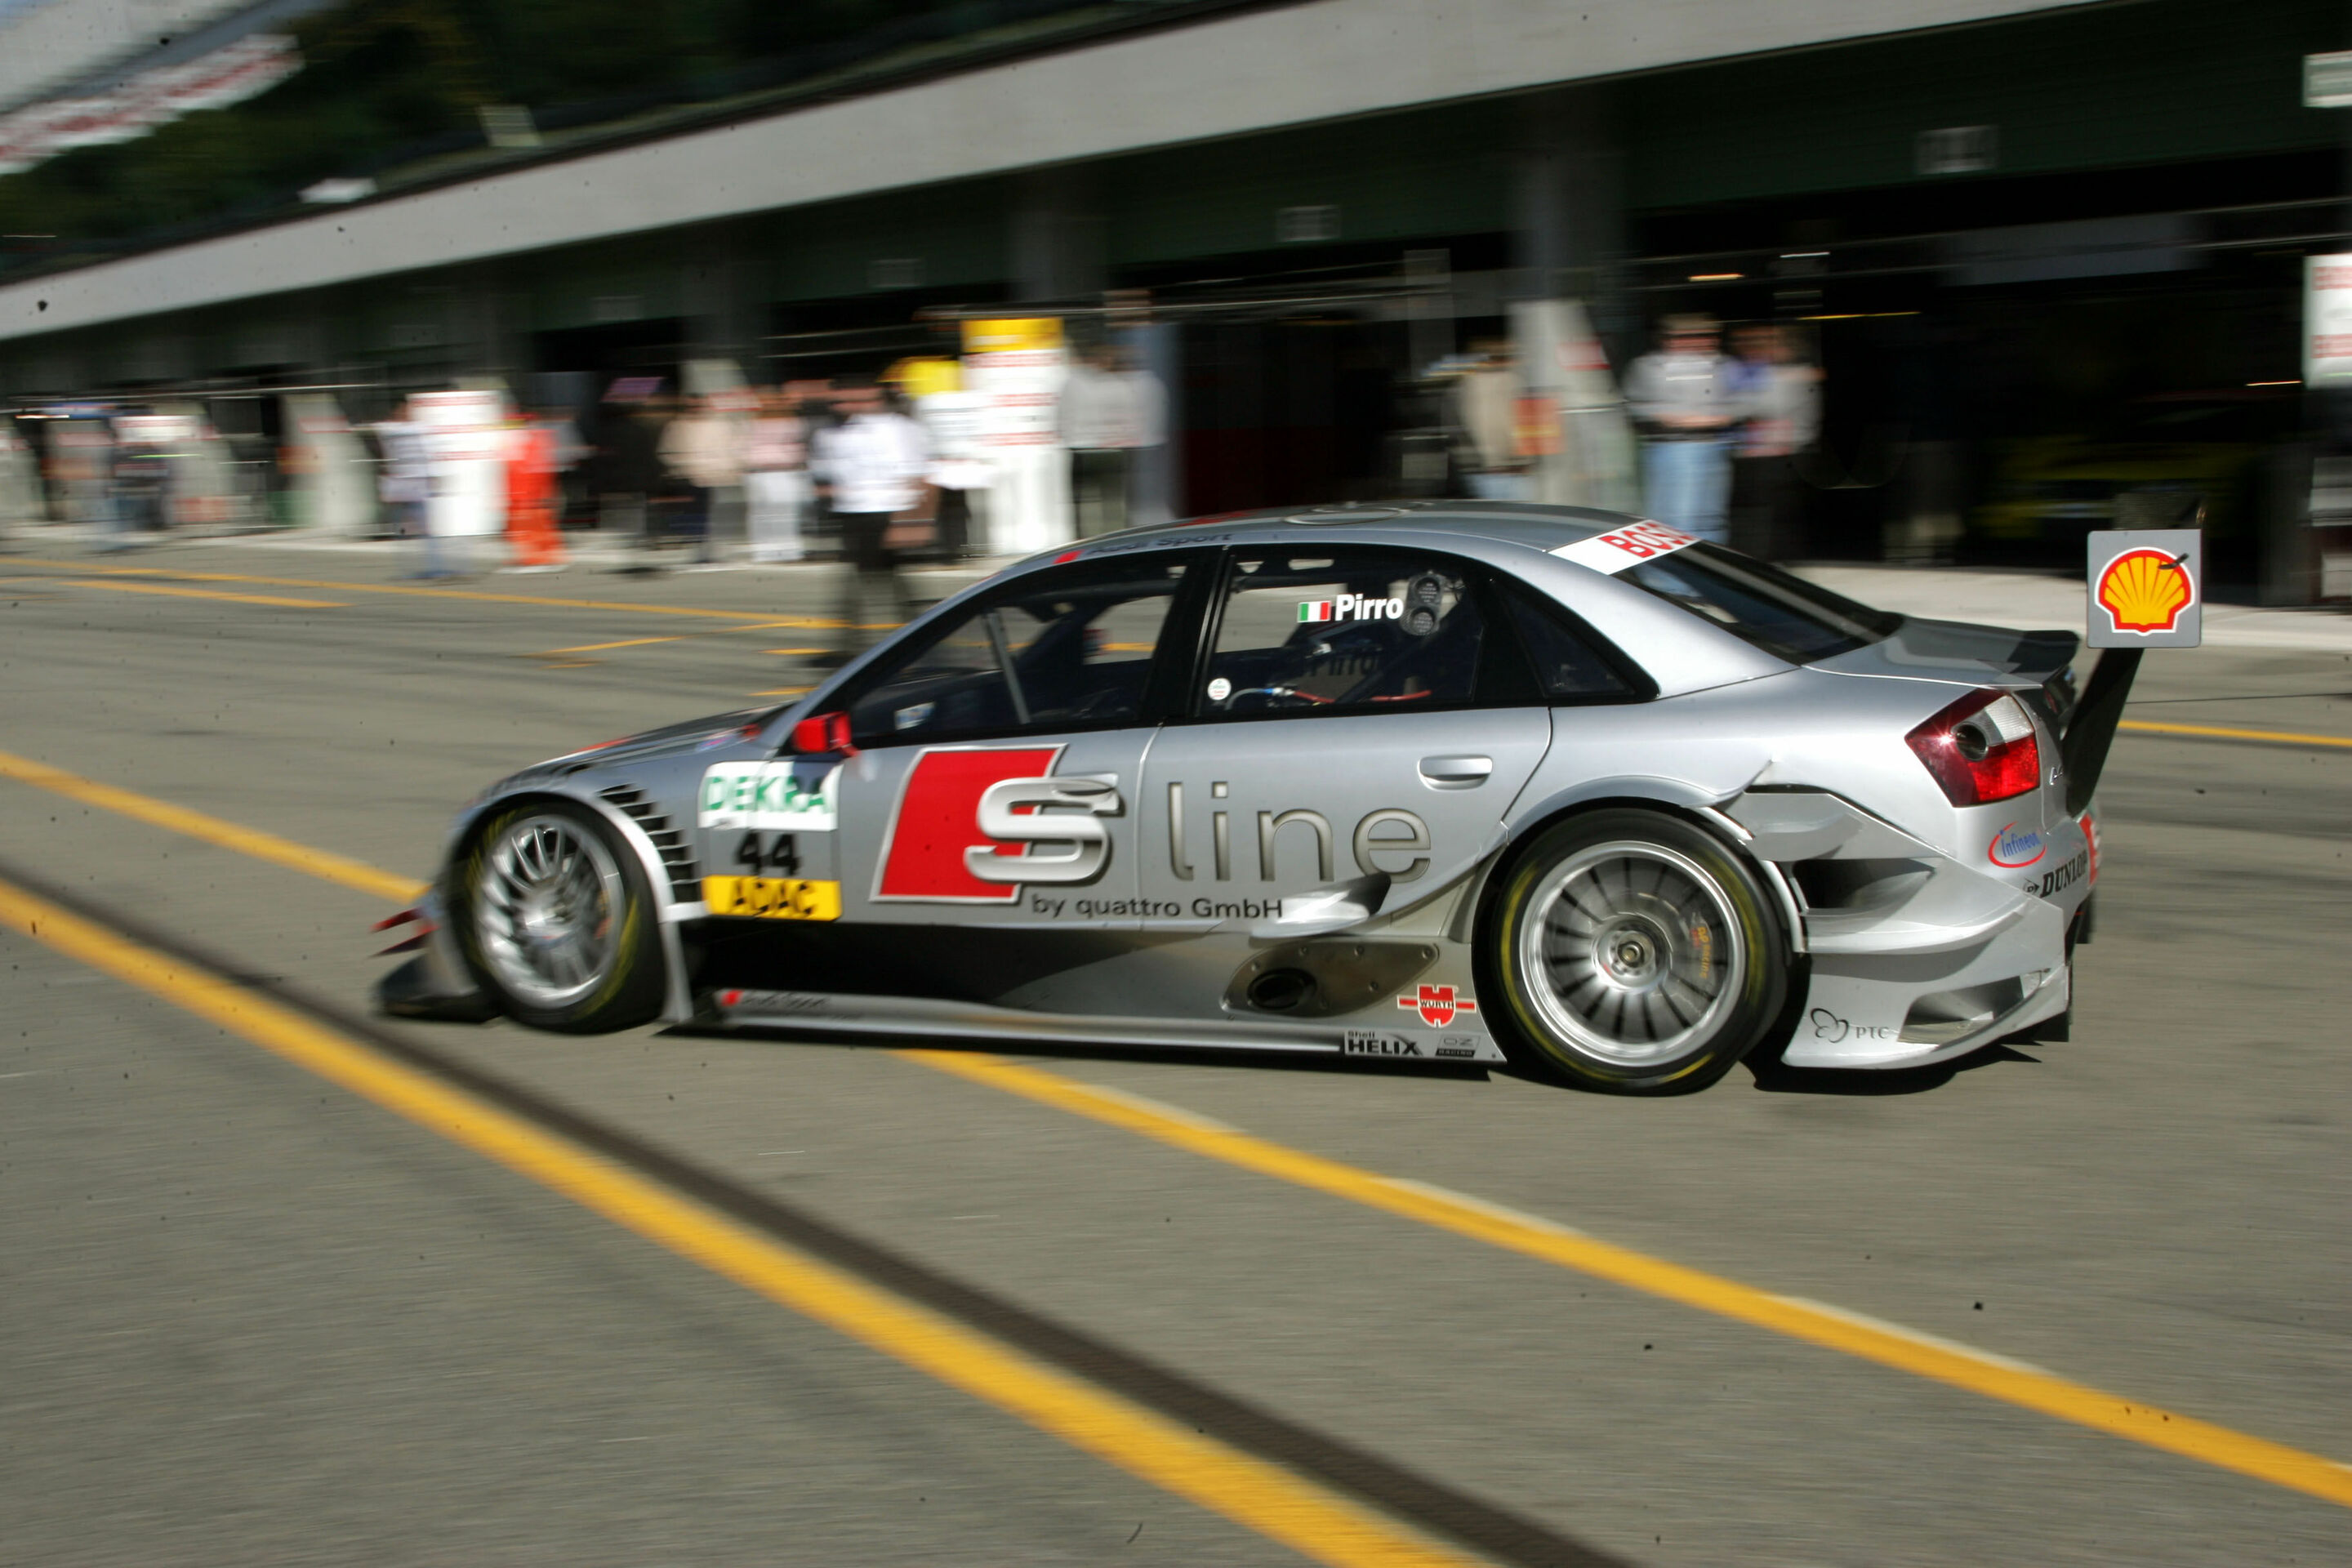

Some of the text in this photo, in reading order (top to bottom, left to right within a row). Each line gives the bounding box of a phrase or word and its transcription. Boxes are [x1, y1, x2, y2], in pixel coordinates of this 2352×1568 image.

[1155, 533, 1235, 548] Sport
[1598, 521, 1698, 558] BOSC
[1334, 594, 1404, 621] Pirro
[705, 775, 832, 813] DEKRA
[964, 773, 1432, 886] S line
[736, 832, 801, 876] 44
[2040, 849, 2087, 898] DUNLOP
[1031, 893, 1284, 919] by quattro GmbH
[1348, 1031, 1376, 1040] Shell
[1855, 1026, 1890, 1040] PTC
[1348, 1039, 1423, 1057] HELIX
